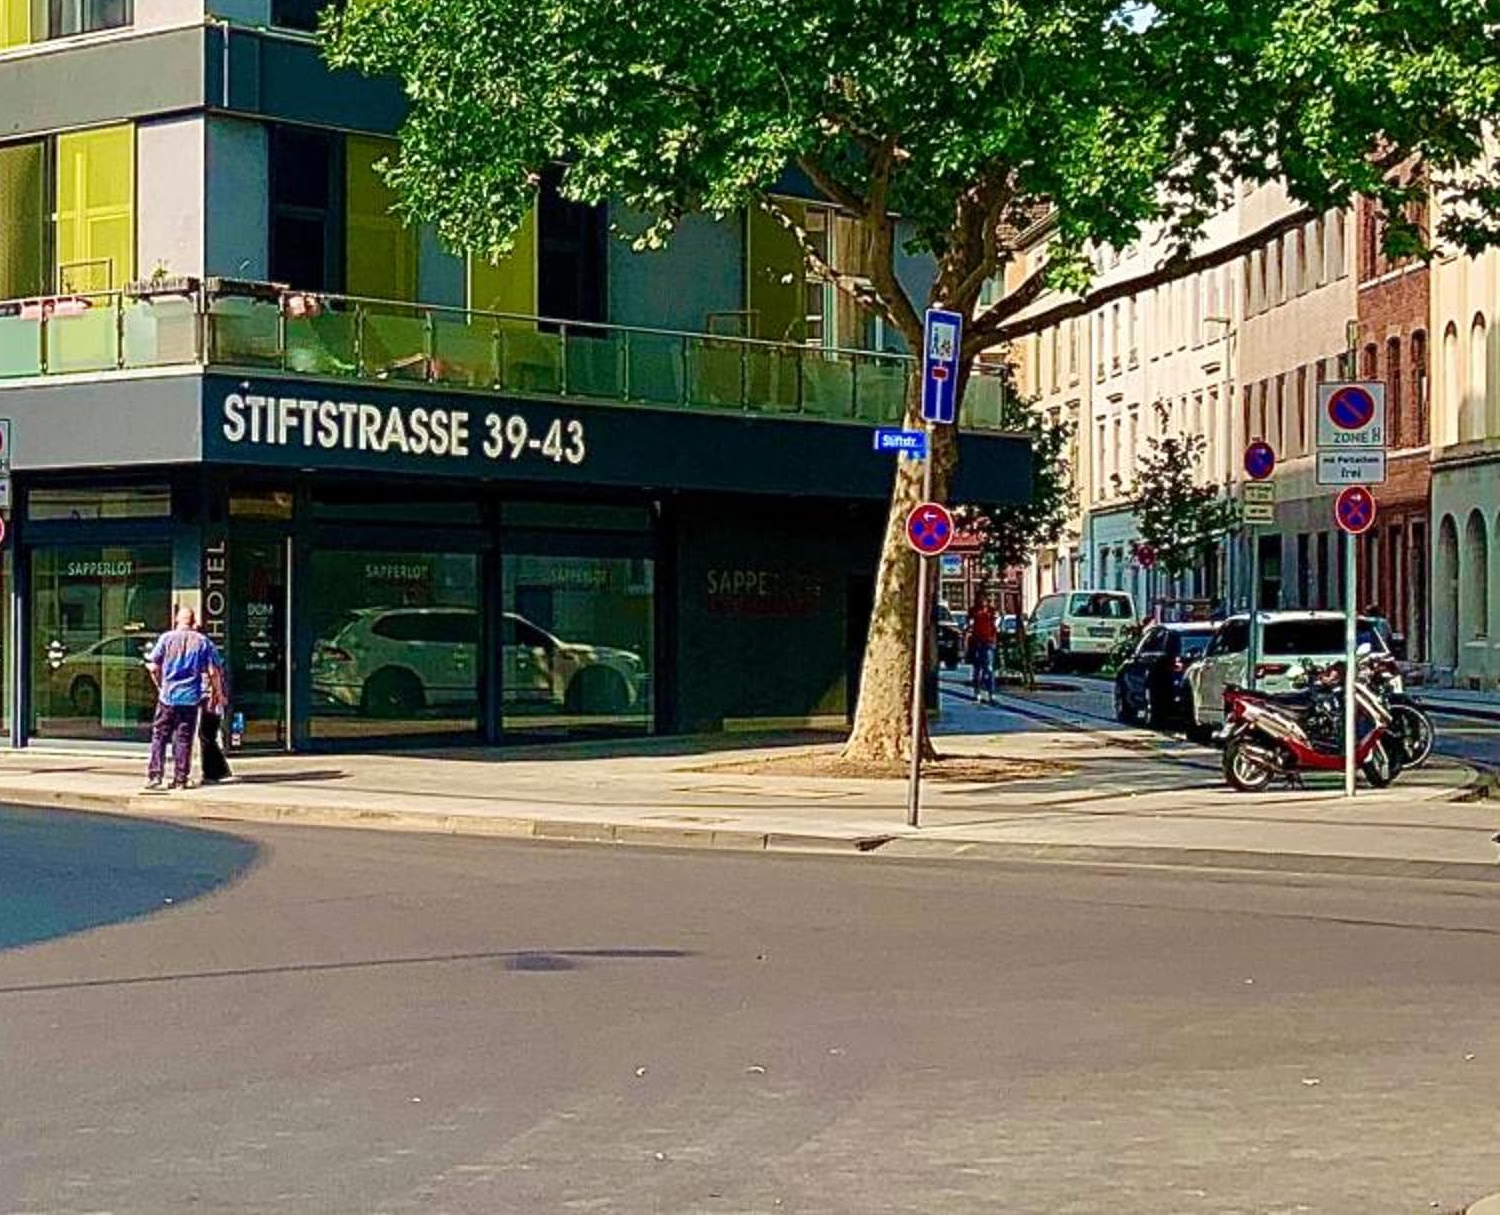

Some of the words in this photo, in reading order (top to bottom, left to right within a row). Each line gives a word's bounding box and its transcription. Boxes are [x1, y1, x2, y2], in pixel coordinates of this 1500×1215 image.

[223, 394, 469, 456] STIFTSTRASSE
[483, 413, 585, 464] 39-43
[1333, 432, 1368, 444] ZONE
[67, 561, 133, 577] SAPPERLOT
